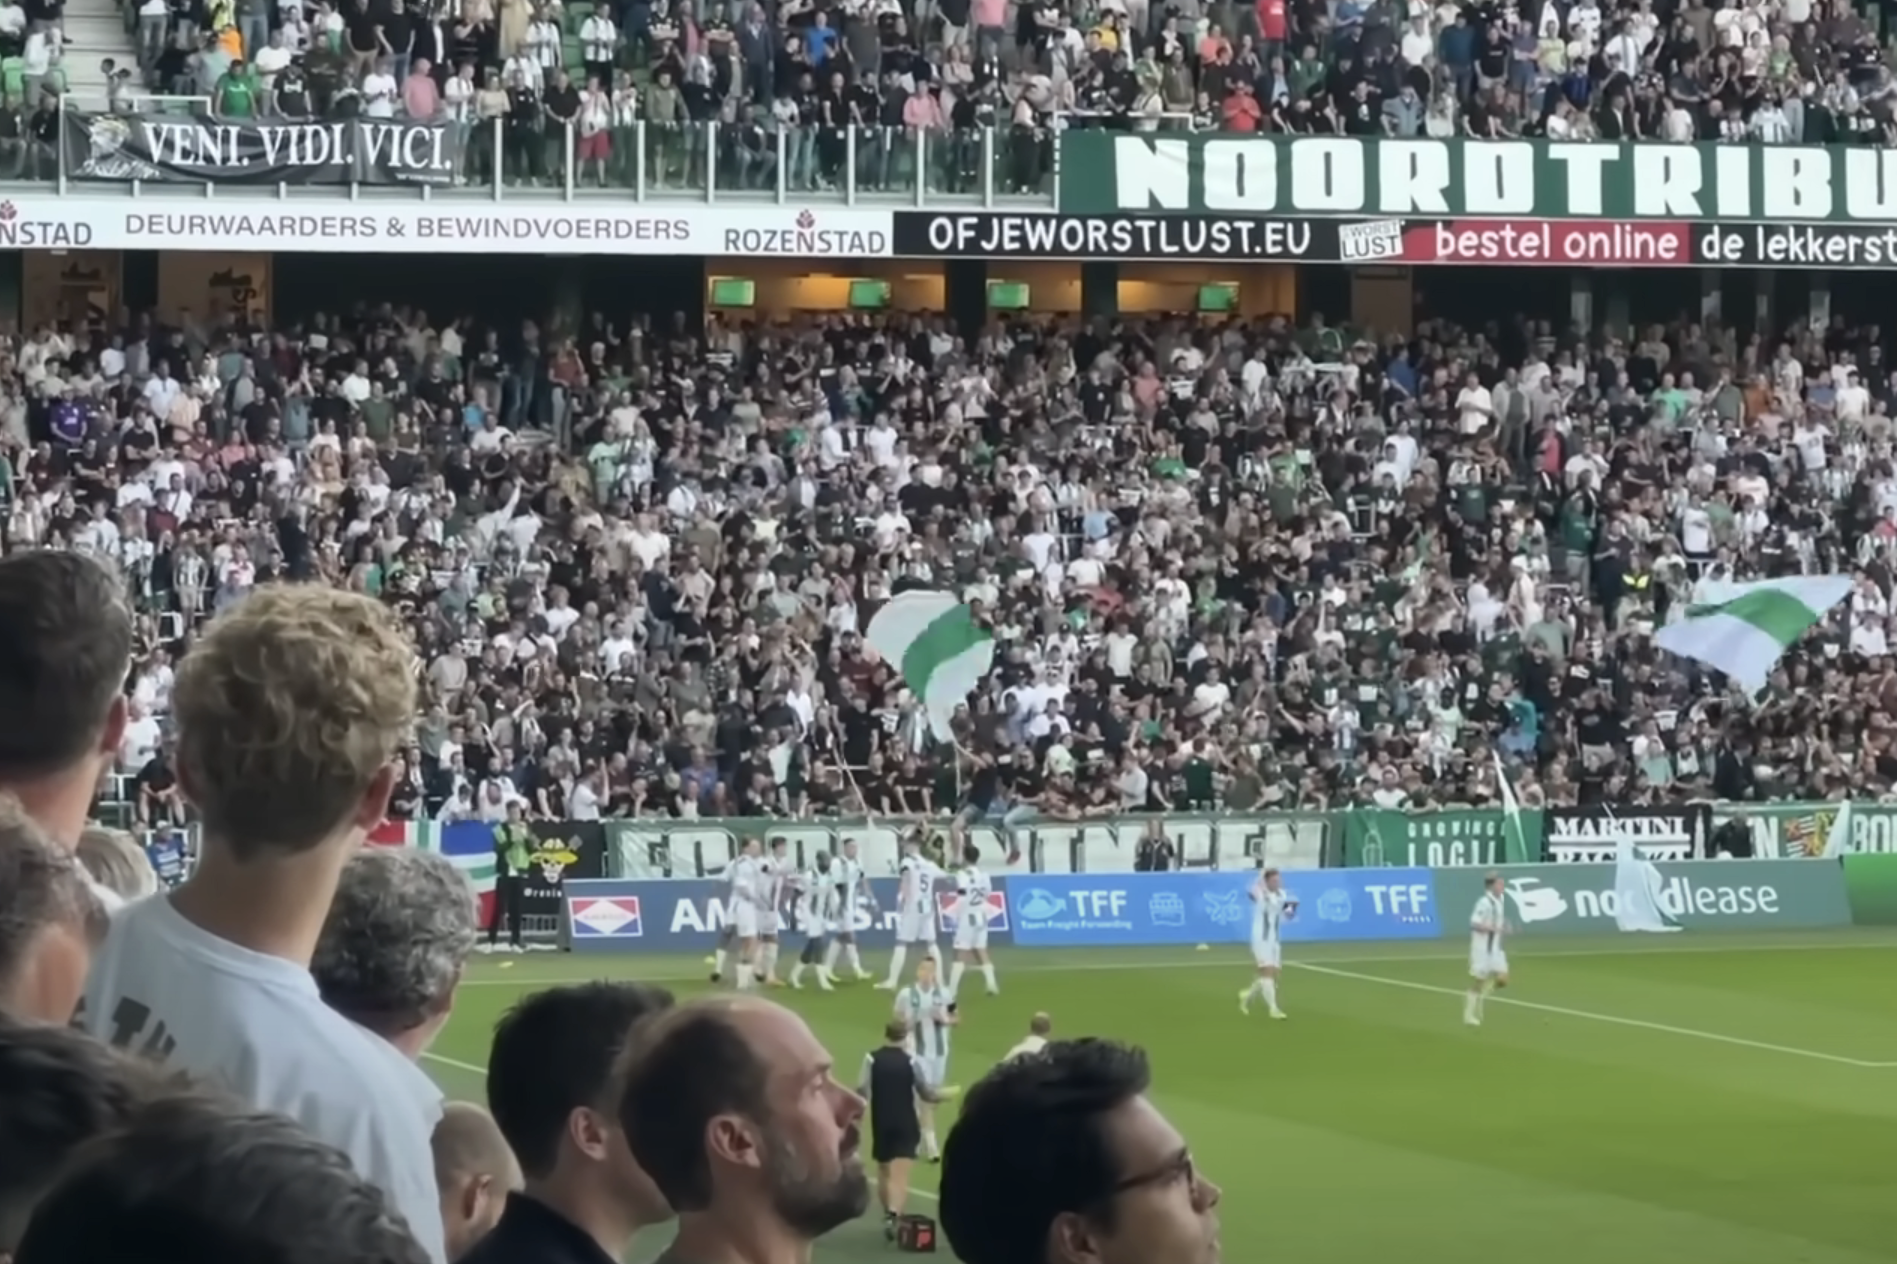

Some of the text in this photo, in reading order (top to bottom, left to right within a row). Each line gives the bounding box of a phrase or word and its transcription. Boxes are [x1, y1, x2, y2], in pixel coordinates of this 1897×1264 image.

[141, 122, 452, 170] VENI. VIDI. VICI.
[125, 214, 690, 240] DEURWAARDERS & BEWINDVOERDERS
[1350, 221, 1398, 237] WORST
[1435, 221, 1679, 260] bestel online
[724, 228, 885, 254] ROZENSTAD
[1342, 234, 1399, 258] LUST
[1701, 225, 1897, 263] de lekkerst
[1068, 890, 1127, 917] TFF
[1364, 884, 1428, 914] TFF
